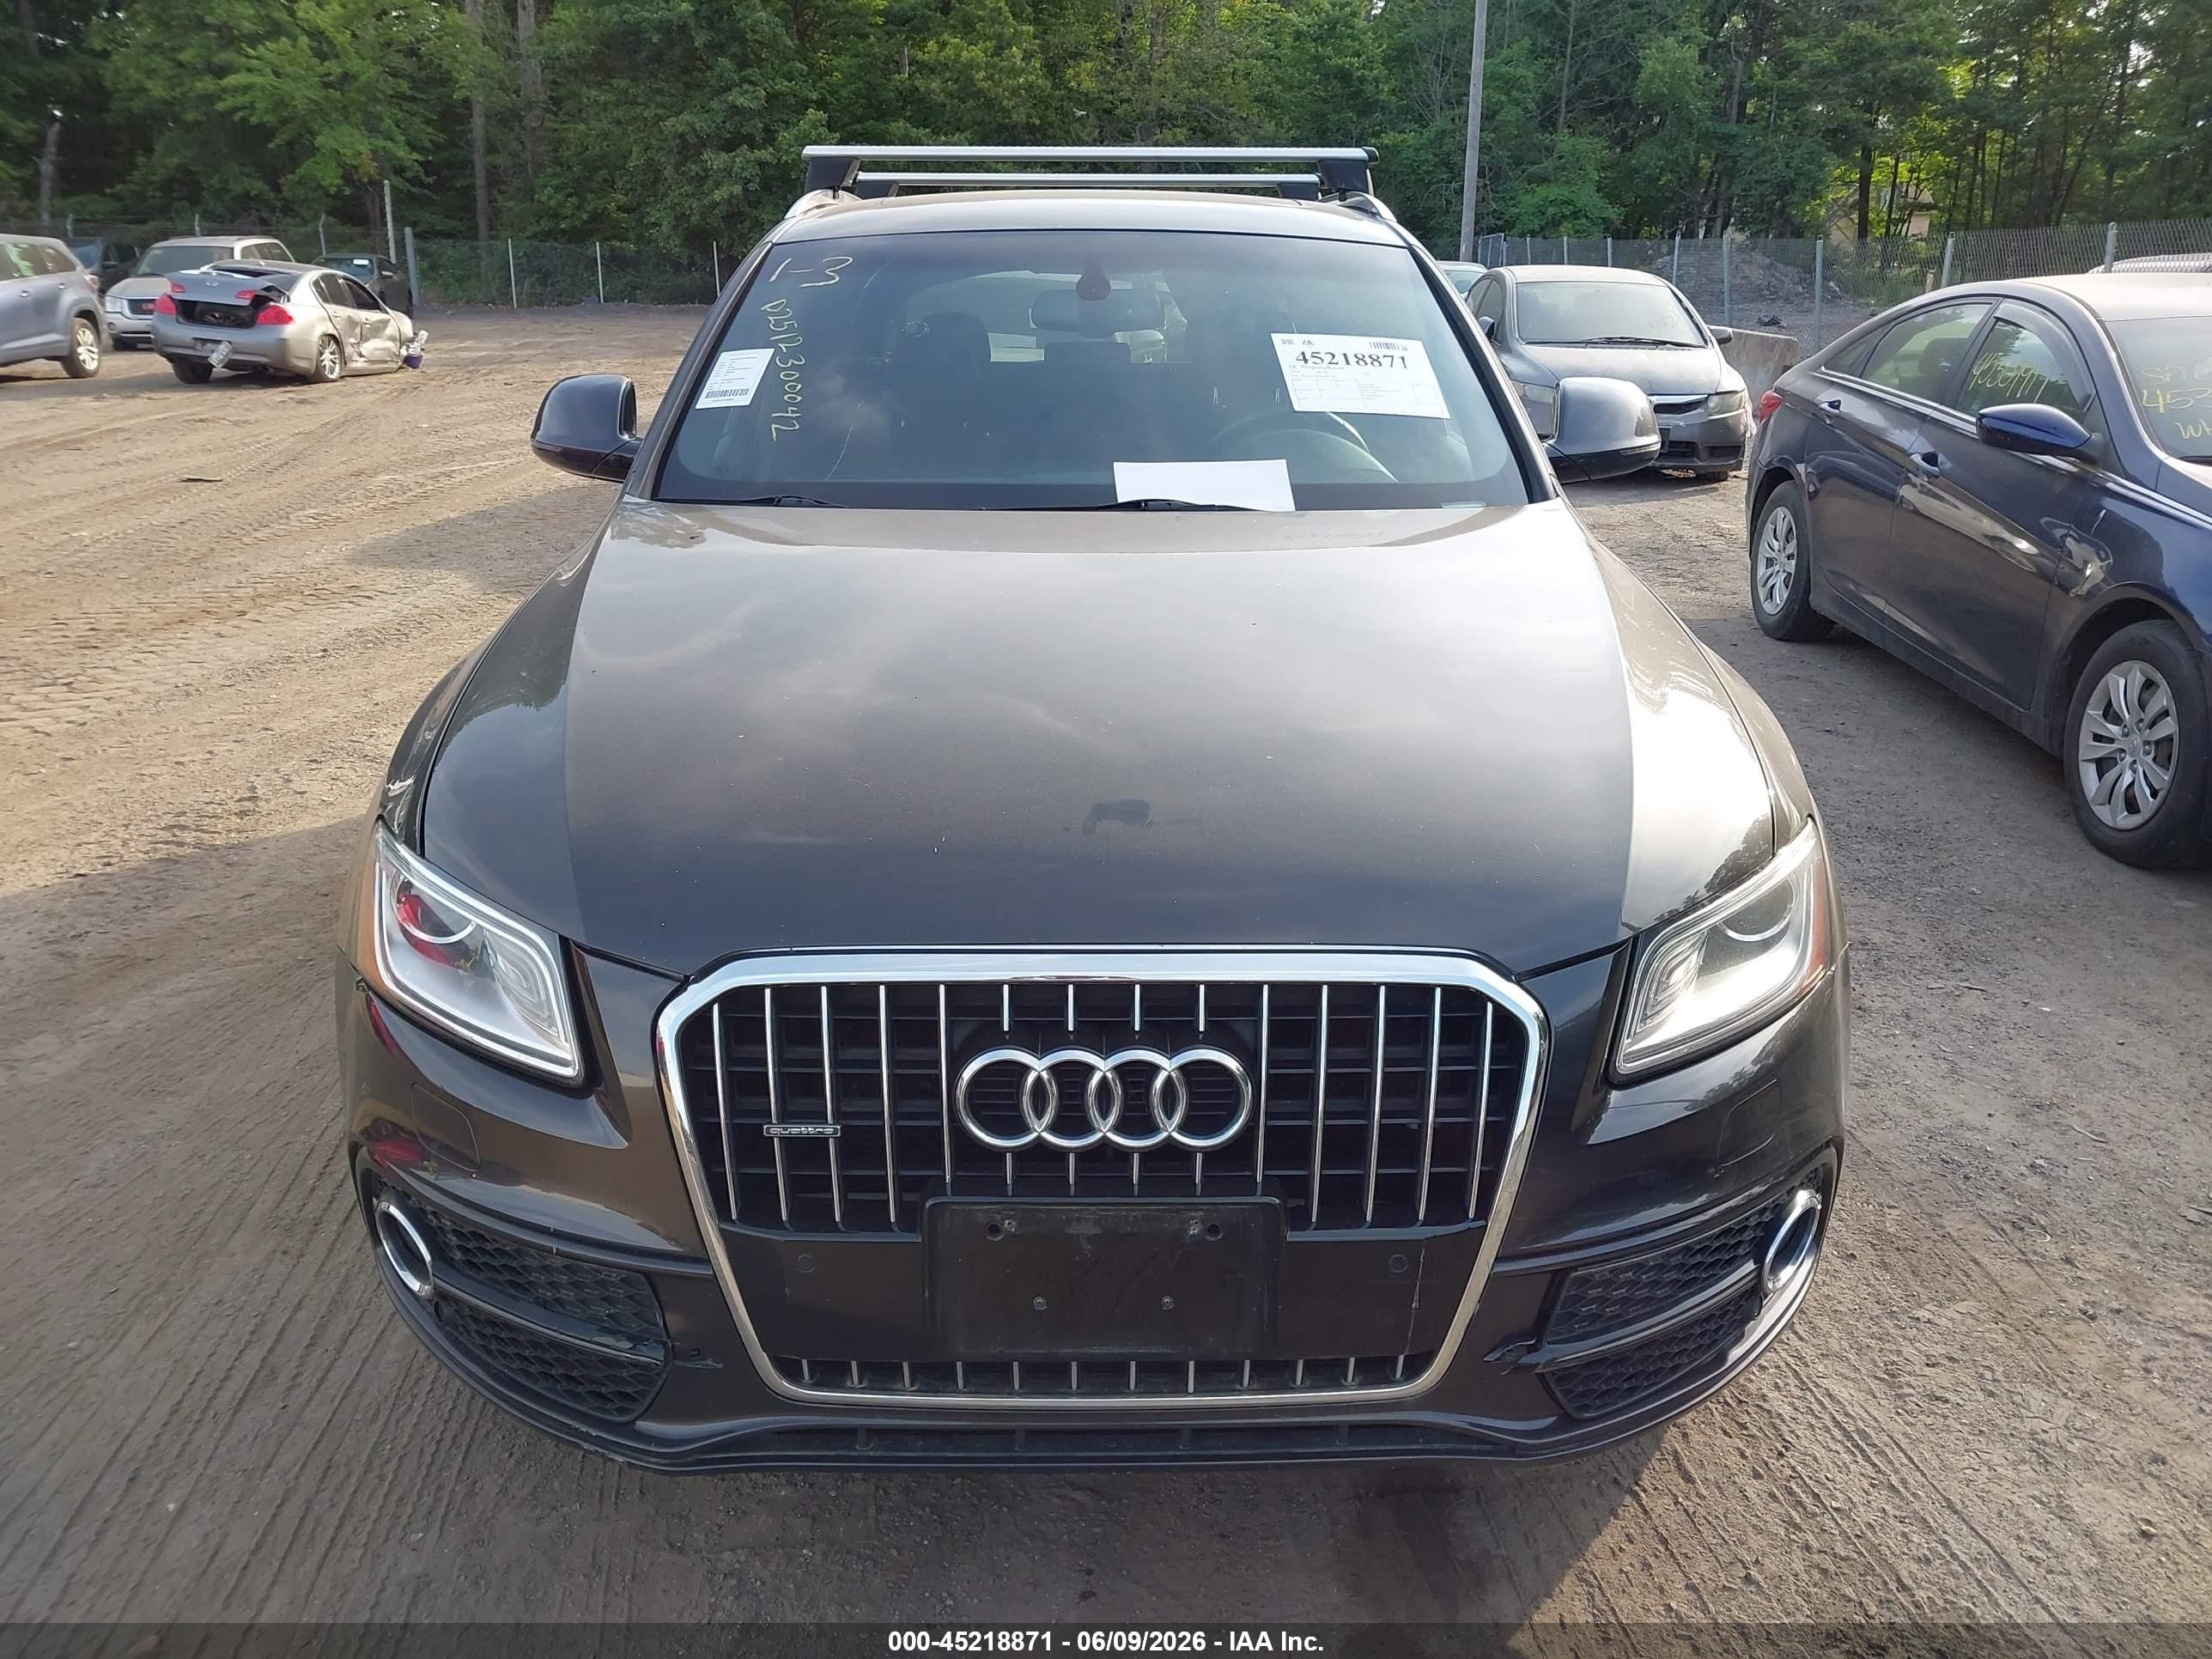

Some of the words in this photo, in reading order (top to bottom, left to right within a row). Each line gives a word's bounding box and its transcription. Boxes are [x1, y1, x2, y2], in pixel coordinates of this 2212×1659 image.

[769, 257, 853, 288] 1-3
[761, 299, 805, 441] D2512300042
[1295, 350, 1408, 370] 45218871
[769, 1127, 835, 1136] quattro
